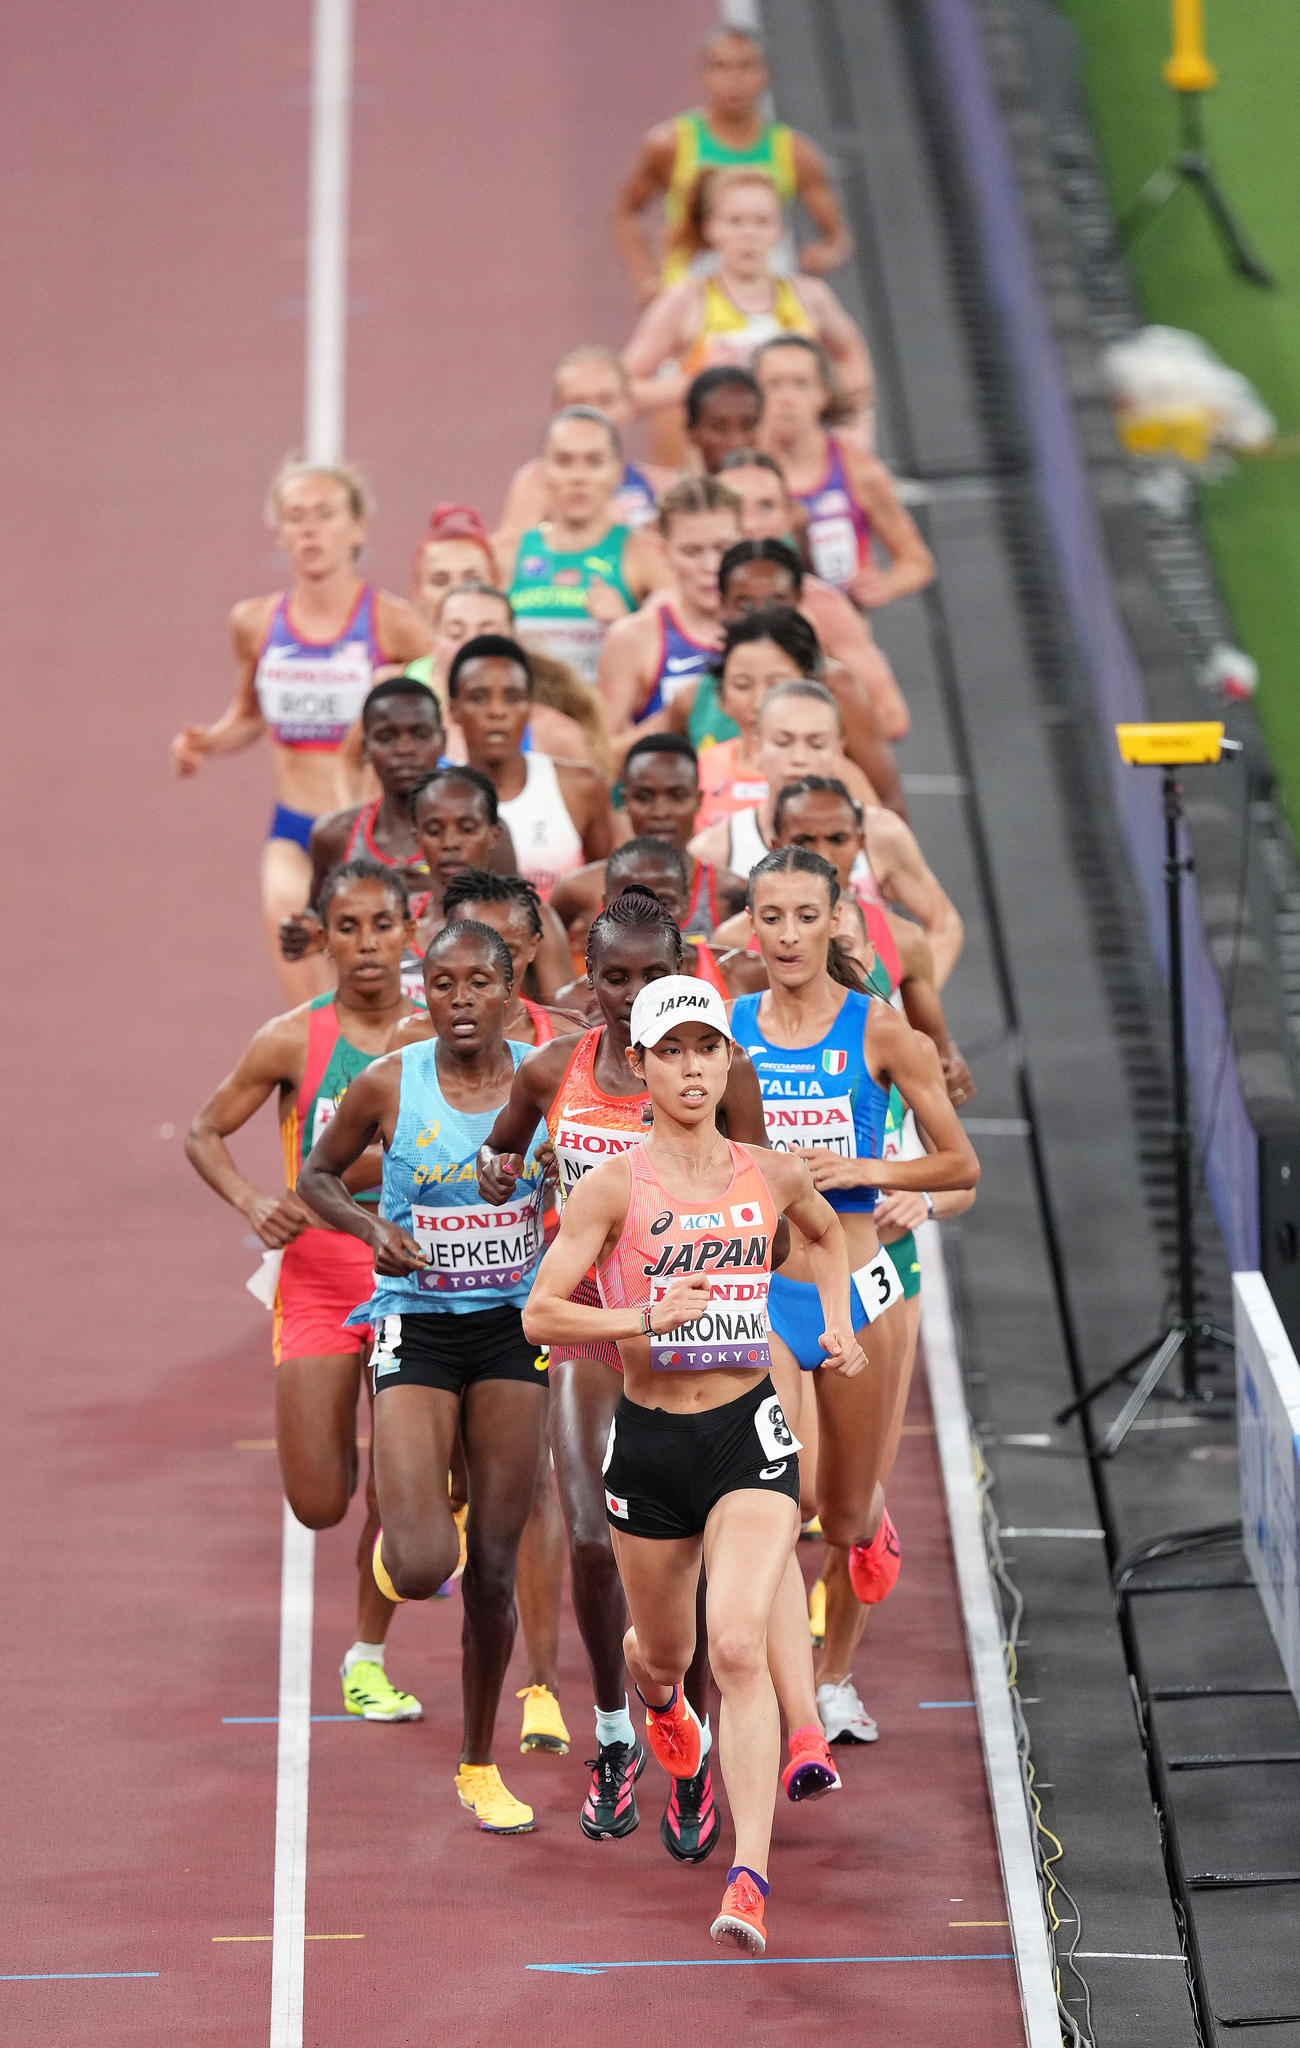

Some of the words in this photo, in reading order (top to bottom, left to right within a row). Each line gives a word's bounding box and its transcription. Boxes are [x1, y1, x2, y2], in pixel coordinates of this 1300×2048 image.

[656, 995, 710, 1017] JAPAN
[759, 1079, 824, 1096] TALIA
[764, 1108, 849, 1127] ONDA
[558, 1131, 639, 1155] HON
[415, 1205, 538, 1231] HONDA
[683, 1213, 721, 1229] ACN
[643, 1236, 768, 1277] JAPAN
[653, 1283, 768, 1302] HNDA
[870, 1265, 891, 1305] 3
[657, 1312, 767, 1342] RONAK
[768, 1404, 793, 1446] 8
